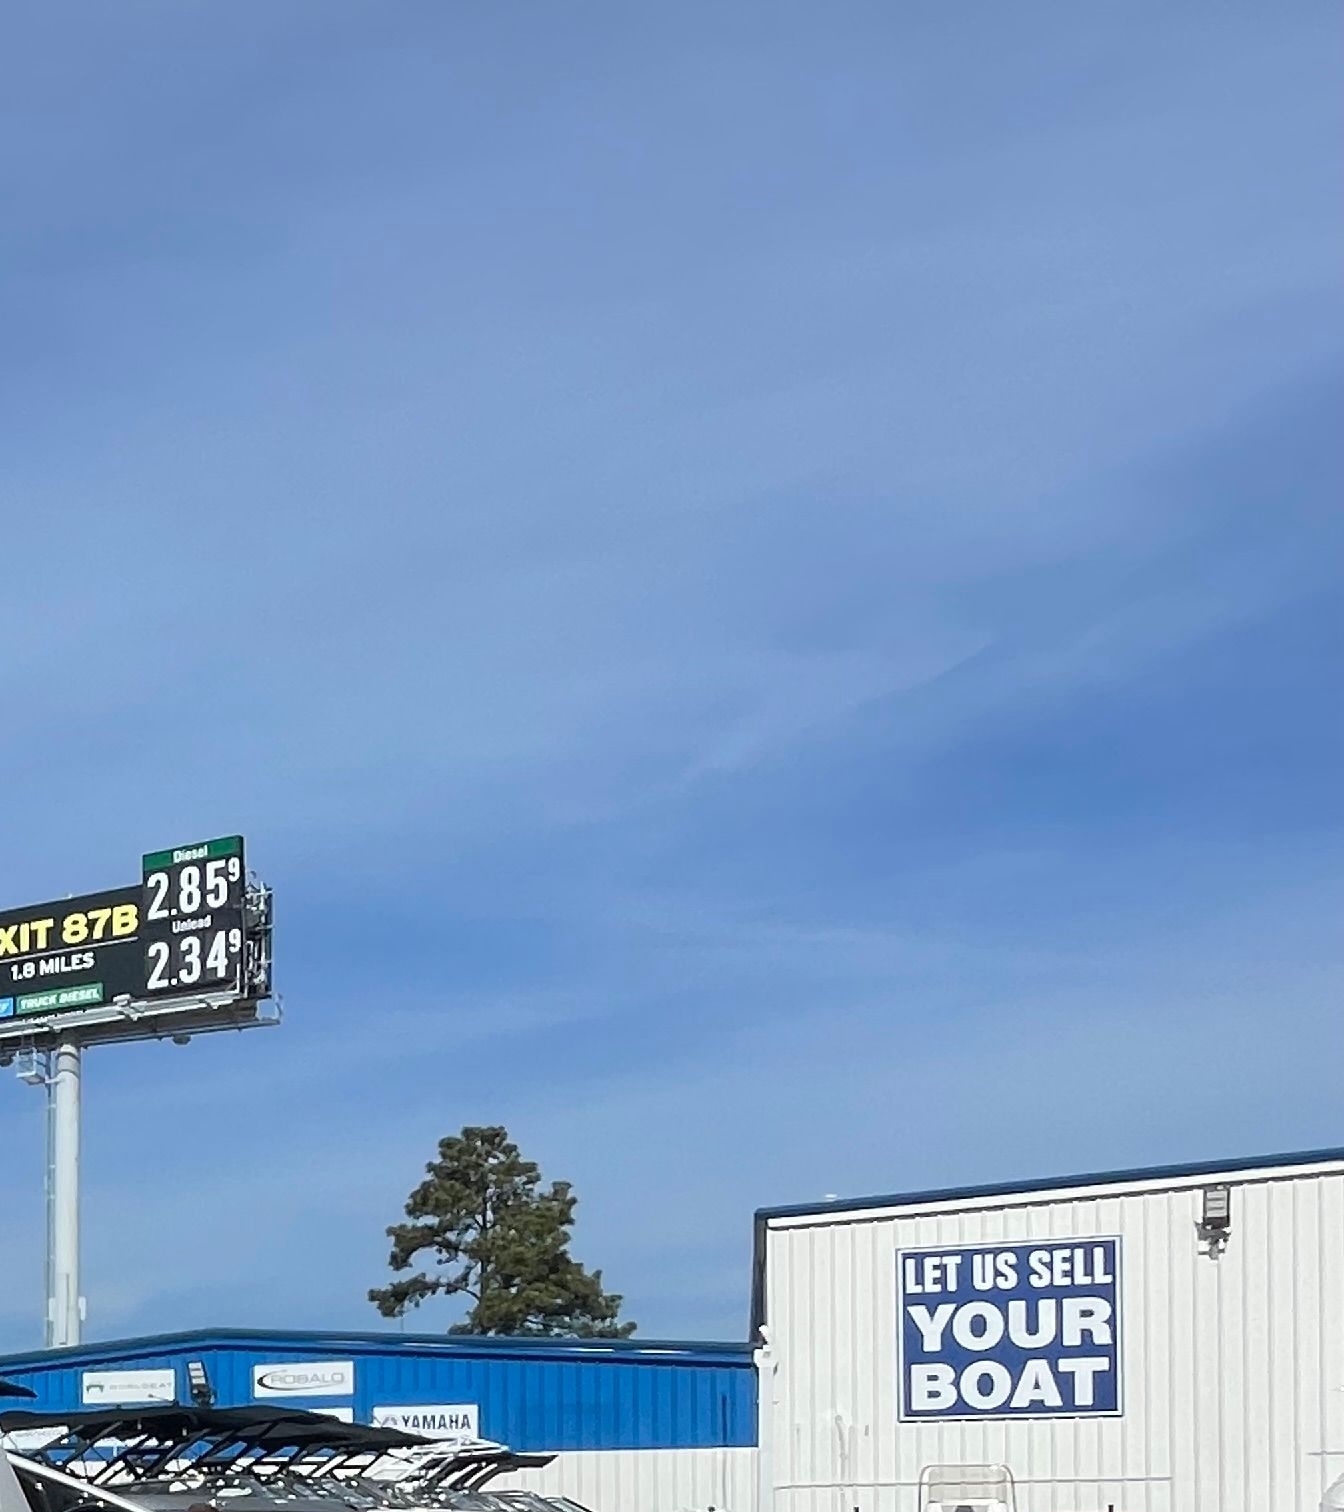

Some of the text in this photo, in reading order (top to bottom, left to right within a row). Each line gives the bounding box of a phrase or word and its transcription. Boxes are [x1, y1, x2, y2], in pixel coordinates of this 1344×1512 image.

[172, 845, 208, 863] Diesel
[61, 904, 139, 945] 87B
[10, 952, 95, 981] 1.8 MILES
[20, 988, 100, 1010] TRUCK DIESEL
[905, 1246, 1113, 1294] LET US SELL
[907, 1297, 1113, 1352] YOUR
[271, 1372, 345, 1385] ROBALO
[910, 1357, 1110, 1411] BOAT
[401, 1414, 471, 1430] YAMAHA
